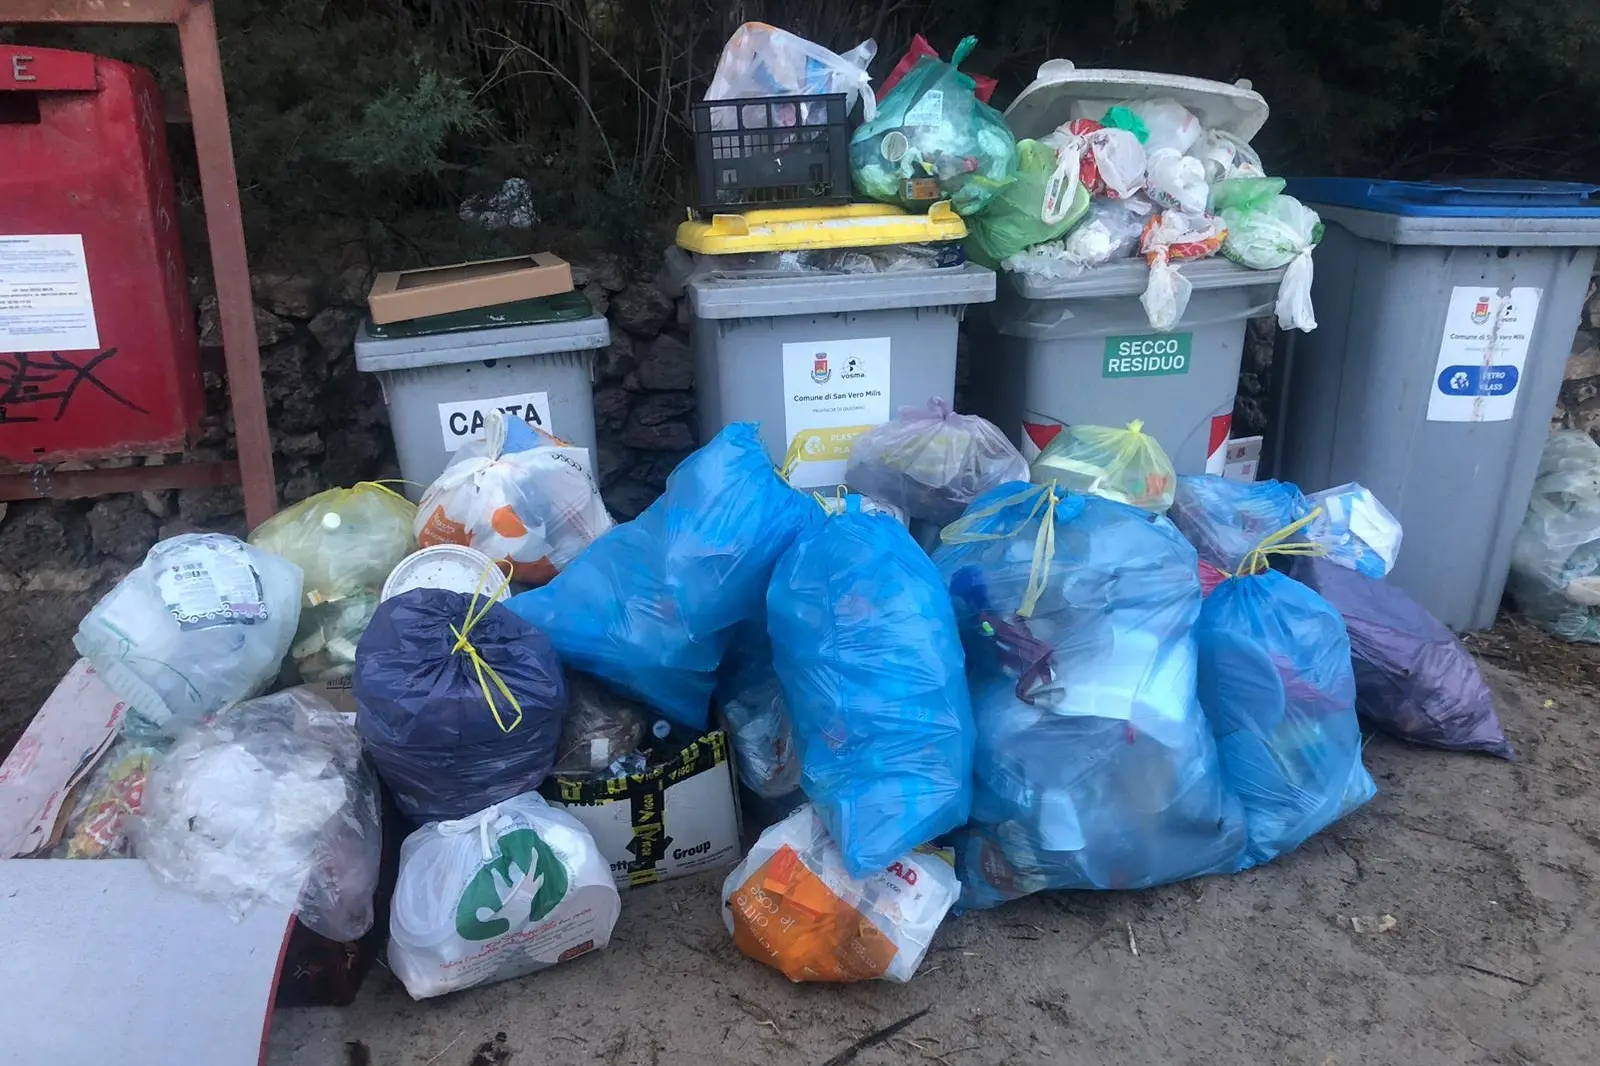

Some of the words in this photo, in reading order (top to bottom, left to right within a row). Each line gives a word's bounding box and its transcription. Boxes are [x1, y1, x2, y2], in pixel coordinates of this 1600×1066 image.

[1118, 340, 1178, 356] SECCO
[1108, 355, 1185, 372] RESIDUO
[794, 393, 823, 402] Comune
[833, 392, 846, 400] San
[848, 391, 864, 399] Vero
[449, 403, 542, 435] CATA
[672, 840, 711, 860] Group
[750, 883, 779, 916] cose
[779, 916, 796, 934] le
